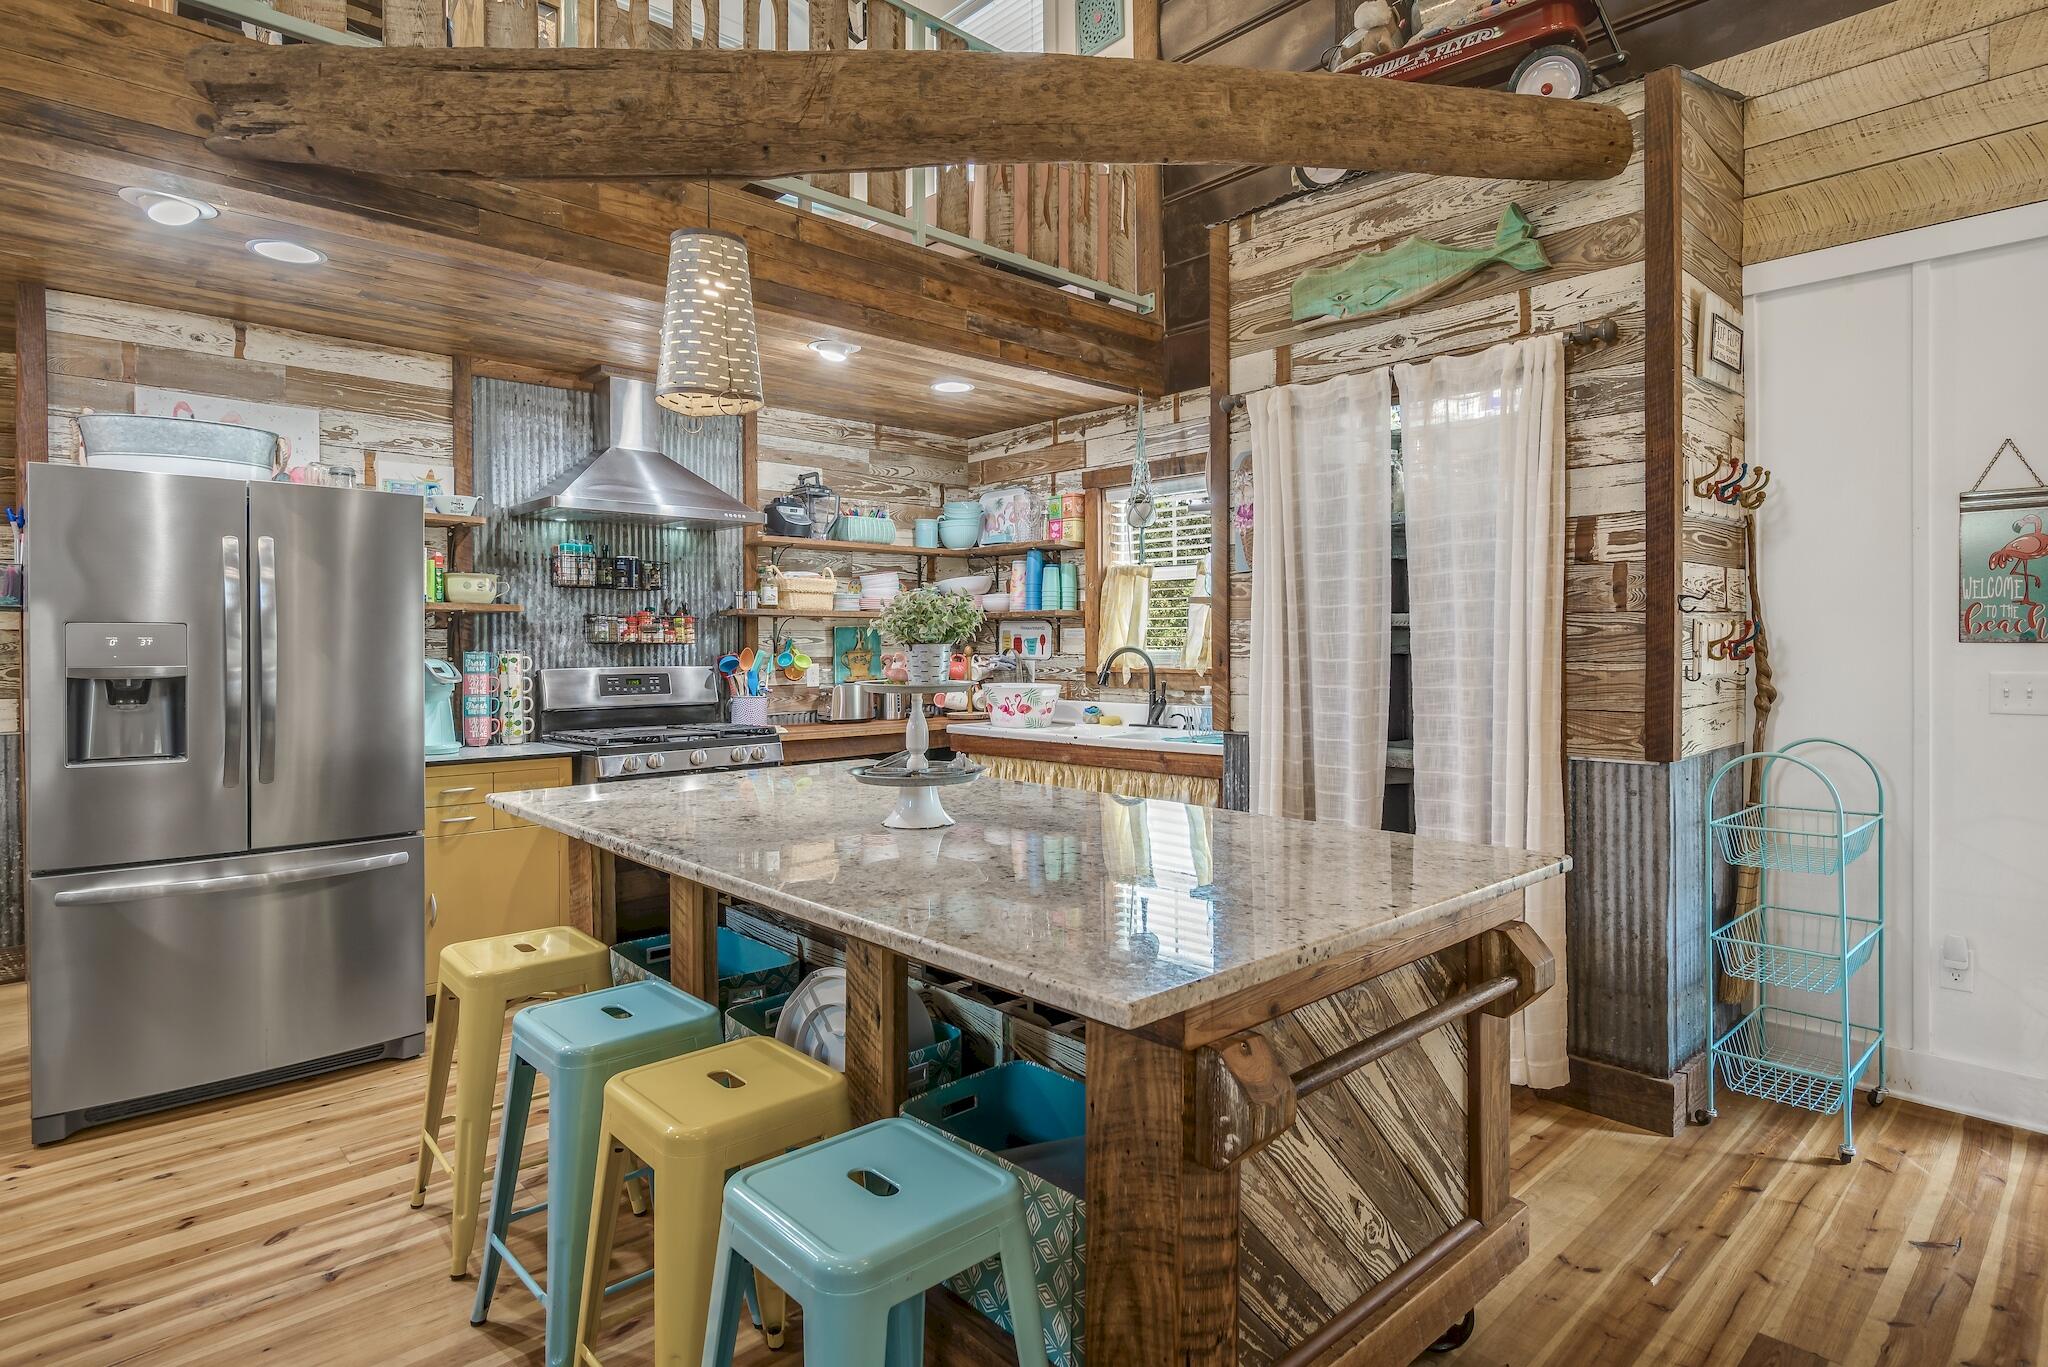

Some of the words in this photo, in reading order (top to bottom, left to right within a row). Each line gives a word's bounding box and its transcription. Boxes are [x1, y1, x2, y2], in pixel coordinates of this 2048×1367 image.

[1434, 28, 1495, 57] FLYER
[1440, 50, 1463, 61] EDITION
[1962, 576, 2024, 600] WELCOME
[1964, 602, 2048, 640] beach
[1984, 604, 1997, 618] TO
[2000, 603, 2019, 619] THE
